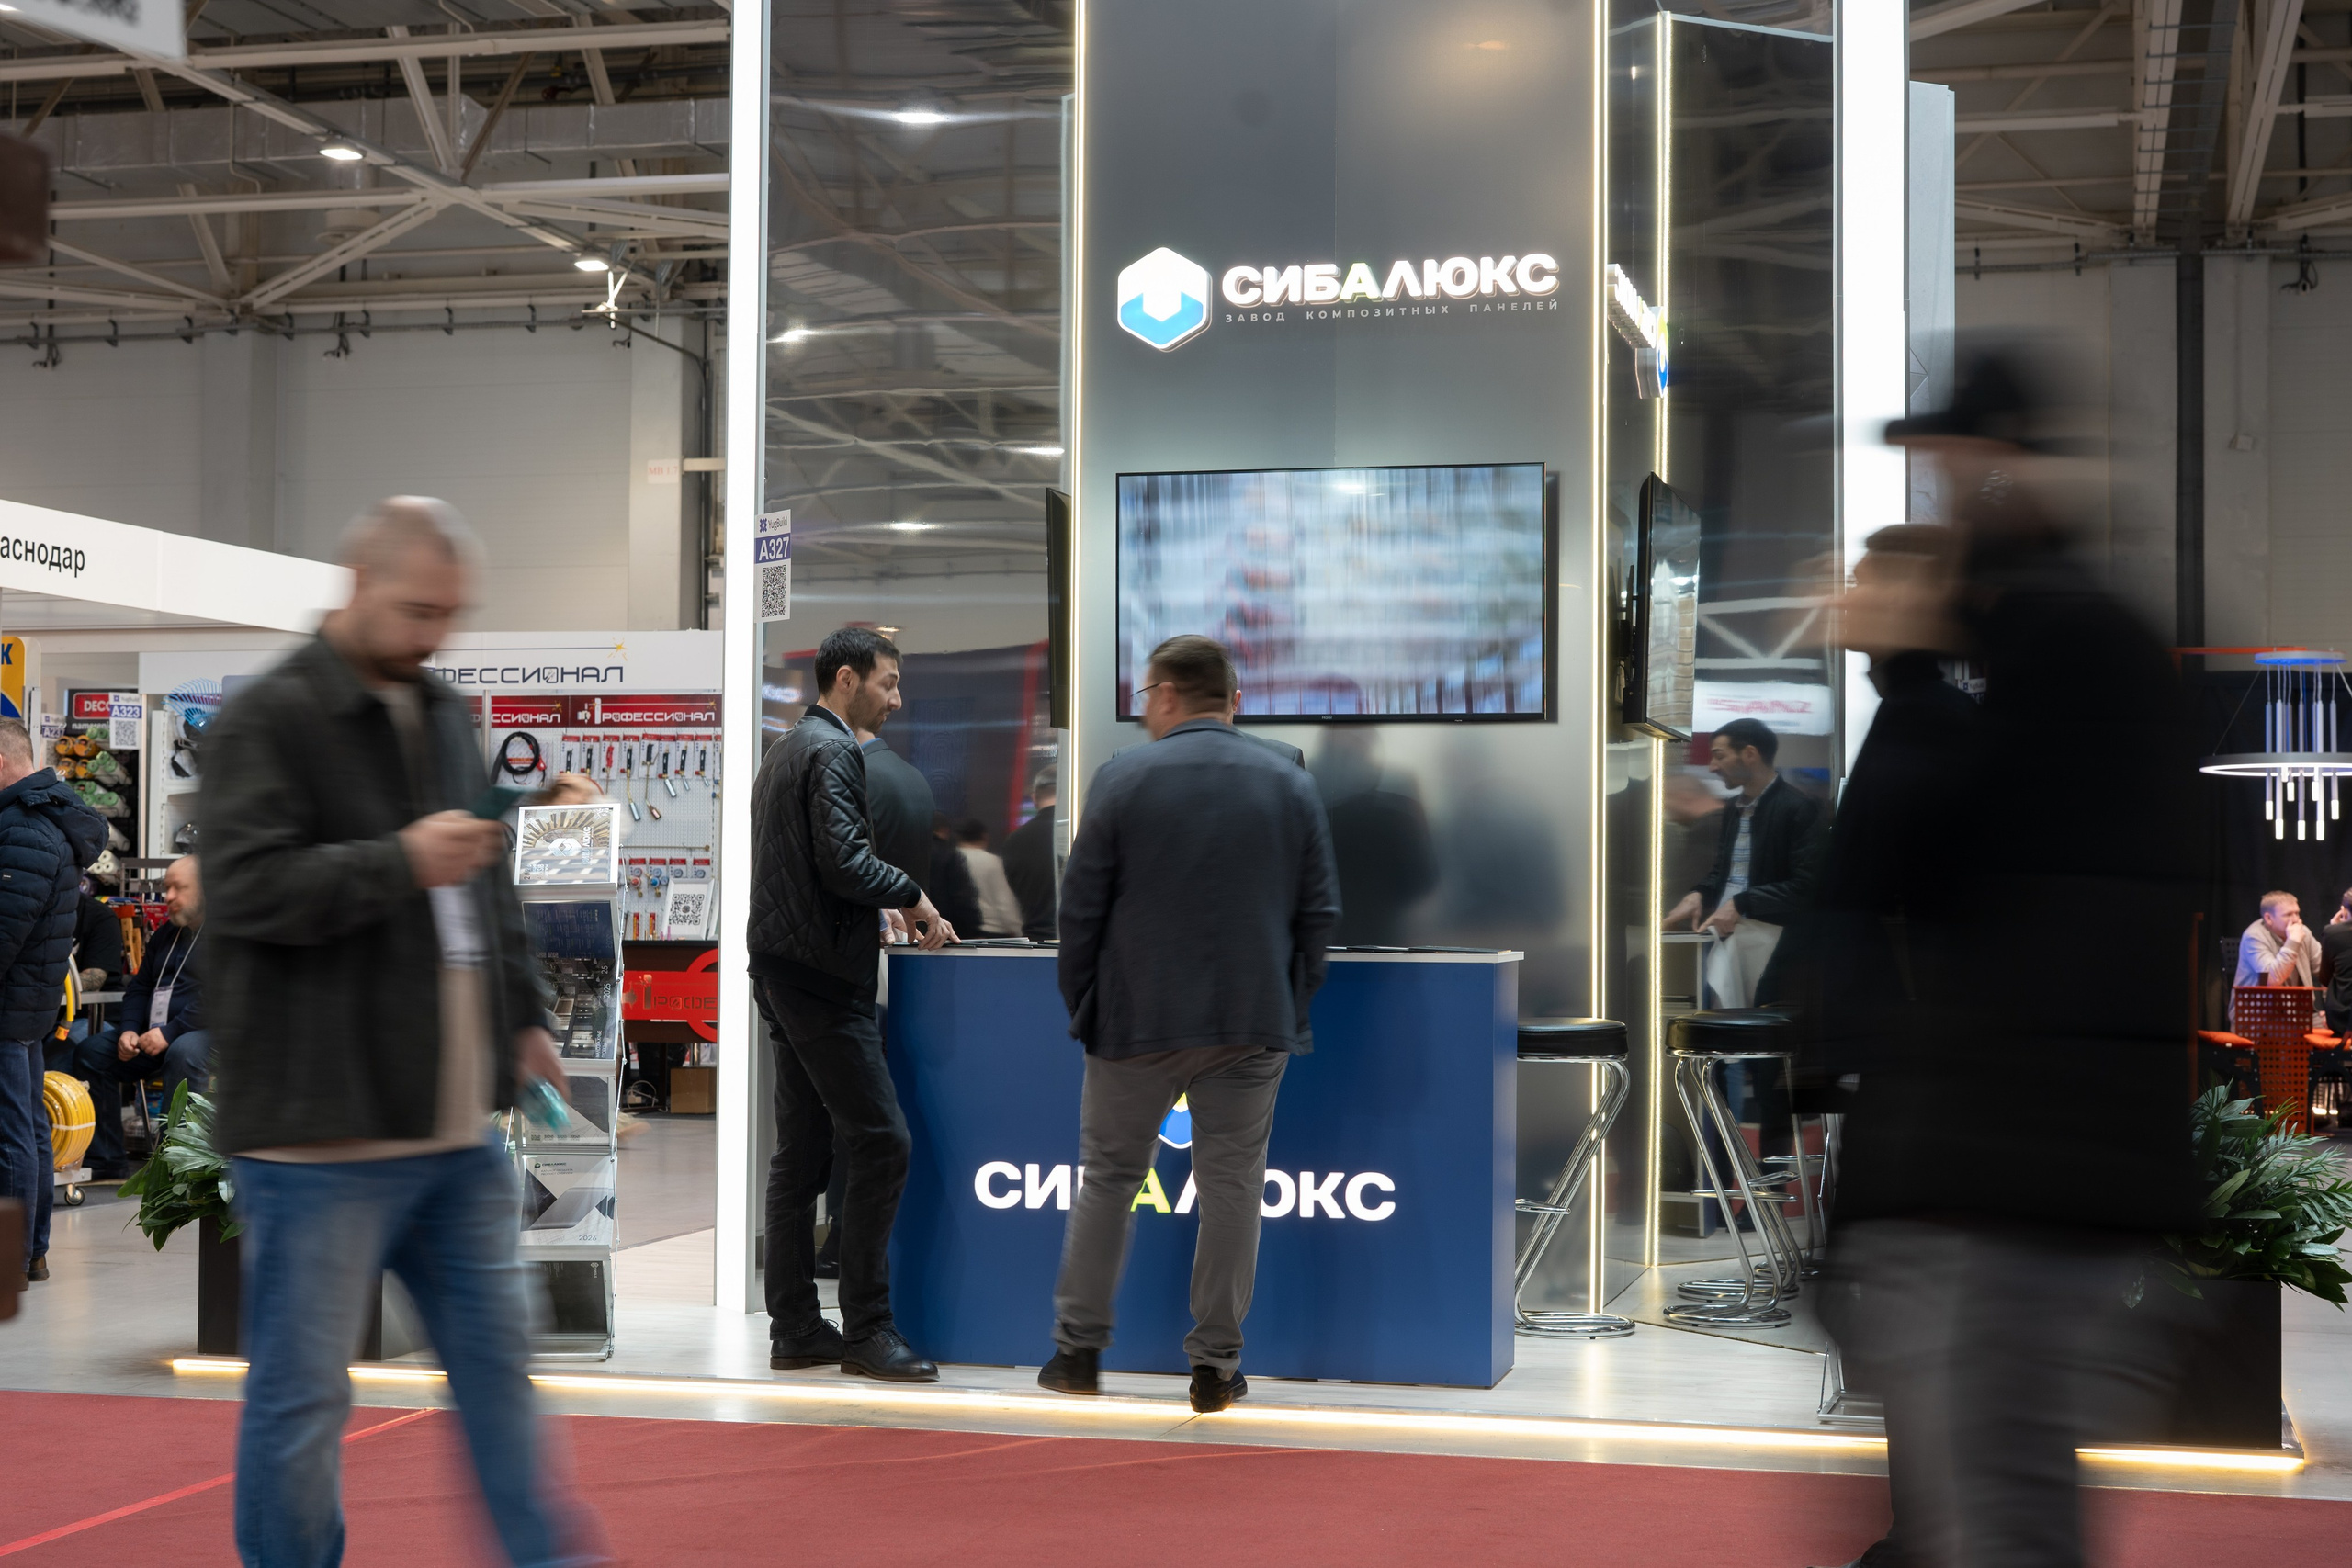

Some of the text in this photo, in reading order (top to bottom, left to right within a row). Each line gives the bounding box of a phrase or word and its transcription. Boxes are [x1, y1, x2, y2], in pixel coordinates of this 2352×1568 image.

[1222, 253, 1559, 307] СИБАЛЮКС
[1226, 299, 1558, 323] ЗАВОД КОМПОЗИТНЫХ ПАНЕЛЕЙ
[768, 516, 787, 531] YugBuild
[0, 536, 85, 578] аснодар
[758, 536, 790, 561] A327
[111, 705, 140, 717] A323
[470, 713, 560, 724] ФССИОНАЛ
[974, 1161, 1396, 1221] СИАКС
